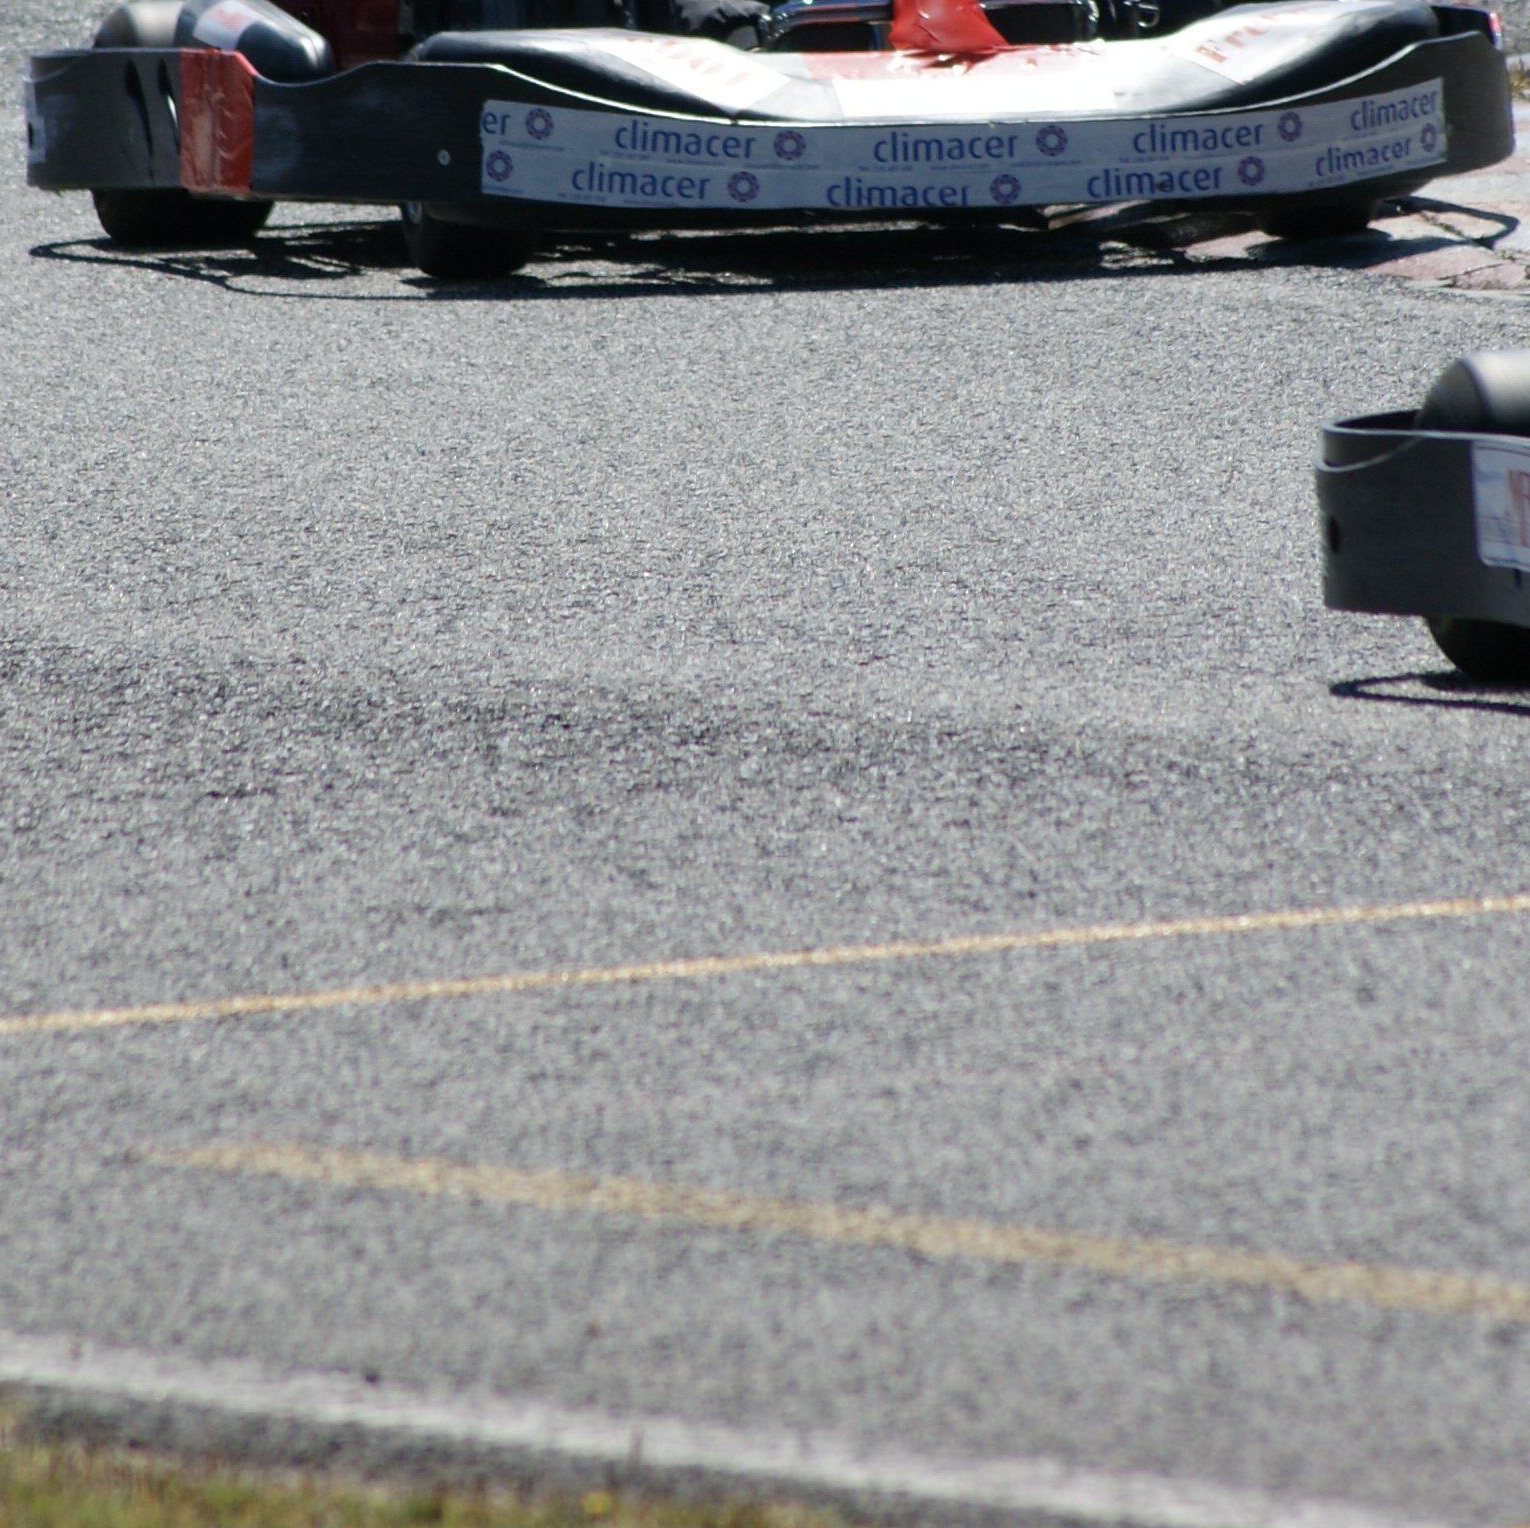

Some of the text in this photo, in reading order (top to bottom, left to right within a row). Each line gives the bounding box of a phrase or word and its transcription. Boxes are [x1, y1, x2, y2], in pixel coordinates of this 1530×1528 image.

[615, 119, 756, 159] climacer
[873, 131, 1019, 163] climacer
[1132, 122, 1265, 155] climacer
[1350, 87, 1438, 132] climacer
[572, 161, 710, 200] climacer
[1087, 164, 1224, 199] climacer
[1315, 136, 1414, 178] climacer
